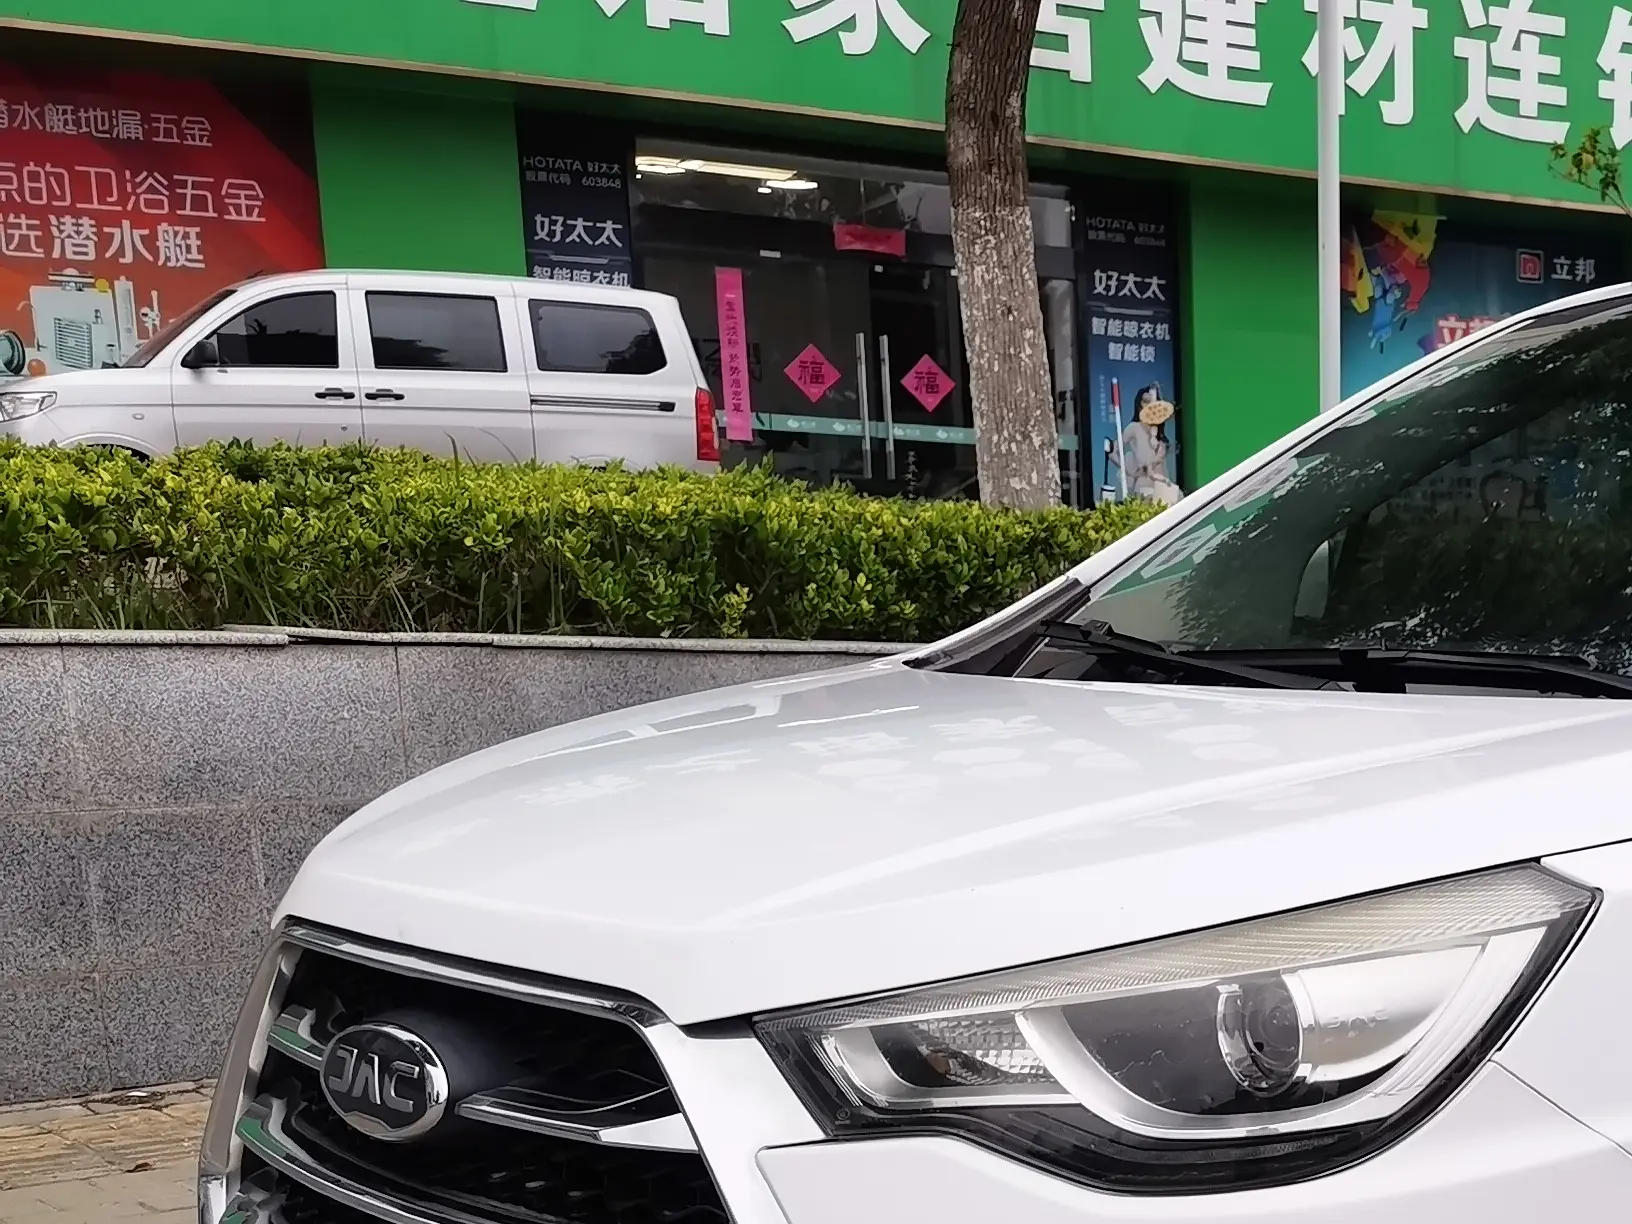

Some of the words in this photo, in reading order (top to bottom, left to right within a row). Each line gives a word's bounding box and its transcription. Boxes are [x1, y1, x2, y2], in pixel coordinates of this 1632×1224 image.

[523, 156, 583, 172] HOTATA
[533, 213, 623, 248] 好太太
[1086, 215, 1136, 232] HOTATA
[1551, 256, 1596, 284] 立邦
[1092, 268, 1167, 301] 好太太
[1091, 316, 1171, 341] 智能晾衣机
[1108, 341, 1156, 363] 智能锁
[797, 356, 826, 385] 福
[914, 366, 940, 395] 福
[328, 1043, 420, 1113] JAC
